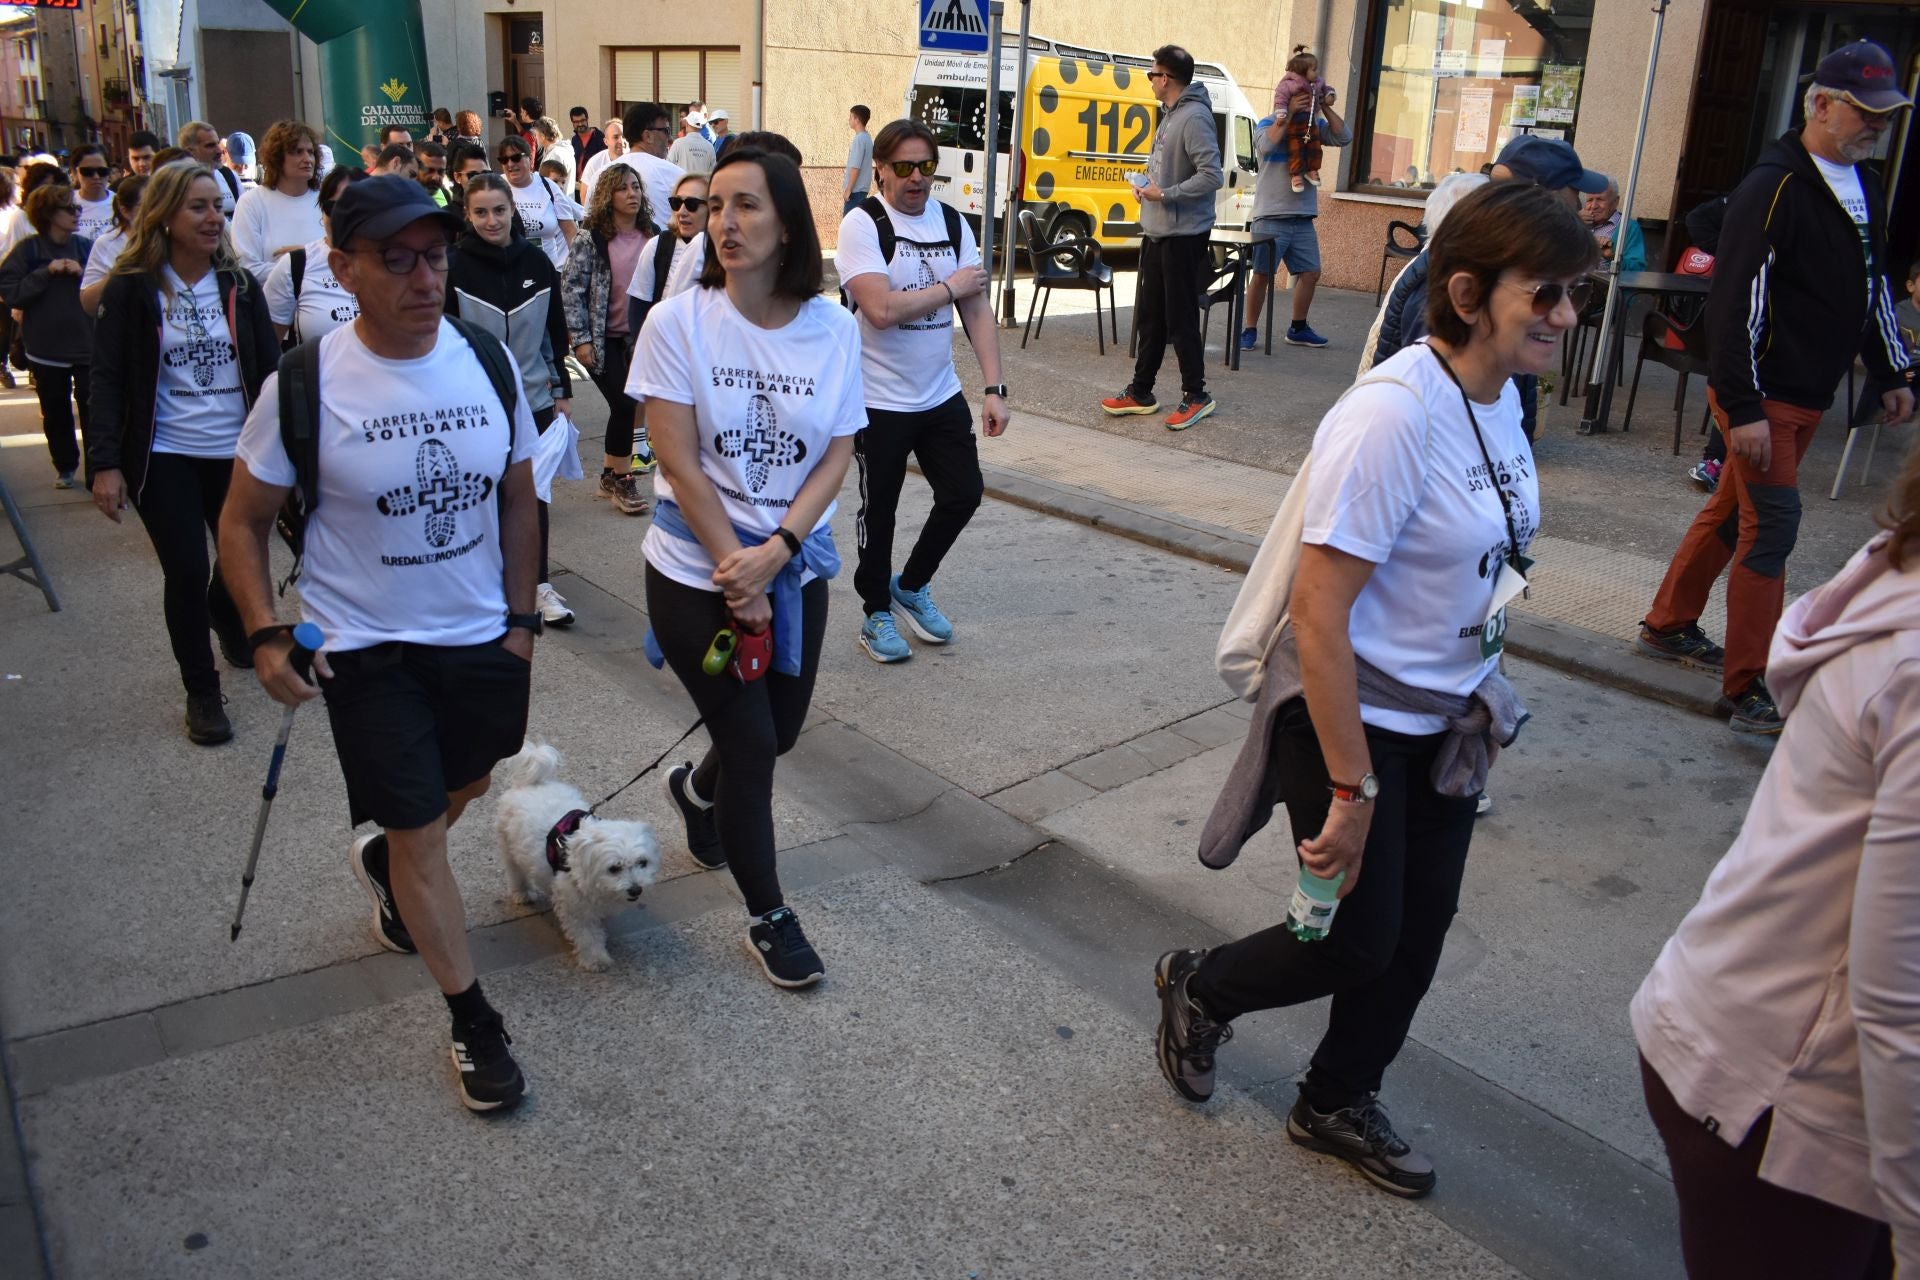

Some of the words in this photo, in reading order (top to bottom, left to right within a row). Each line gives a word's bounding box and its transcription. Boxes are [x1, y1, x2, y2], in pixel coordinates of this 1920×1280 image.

[924, 59, 945, 67] Unidad
[964, 60, 972, 69] de
[936, 73, 987, 83] ambulanc
[362, 105, 391, 116] CAJA
[392, 105, 424, 115] RURAL
[932, 107, 948, 120] 112
[361, 116, 378, 126] DE
[380, 115, 427, 125] NAVARRA
[1078, 99, 1151, 165] 112
[712, 366, 815, 387] CARRERA-MARCHA
[713, 376, 814, 397] SOLIDARIA
[362, 404, 487, 431] CARRERA-MARCHA
[365, 415, 490, 443] SOLIDARIA
